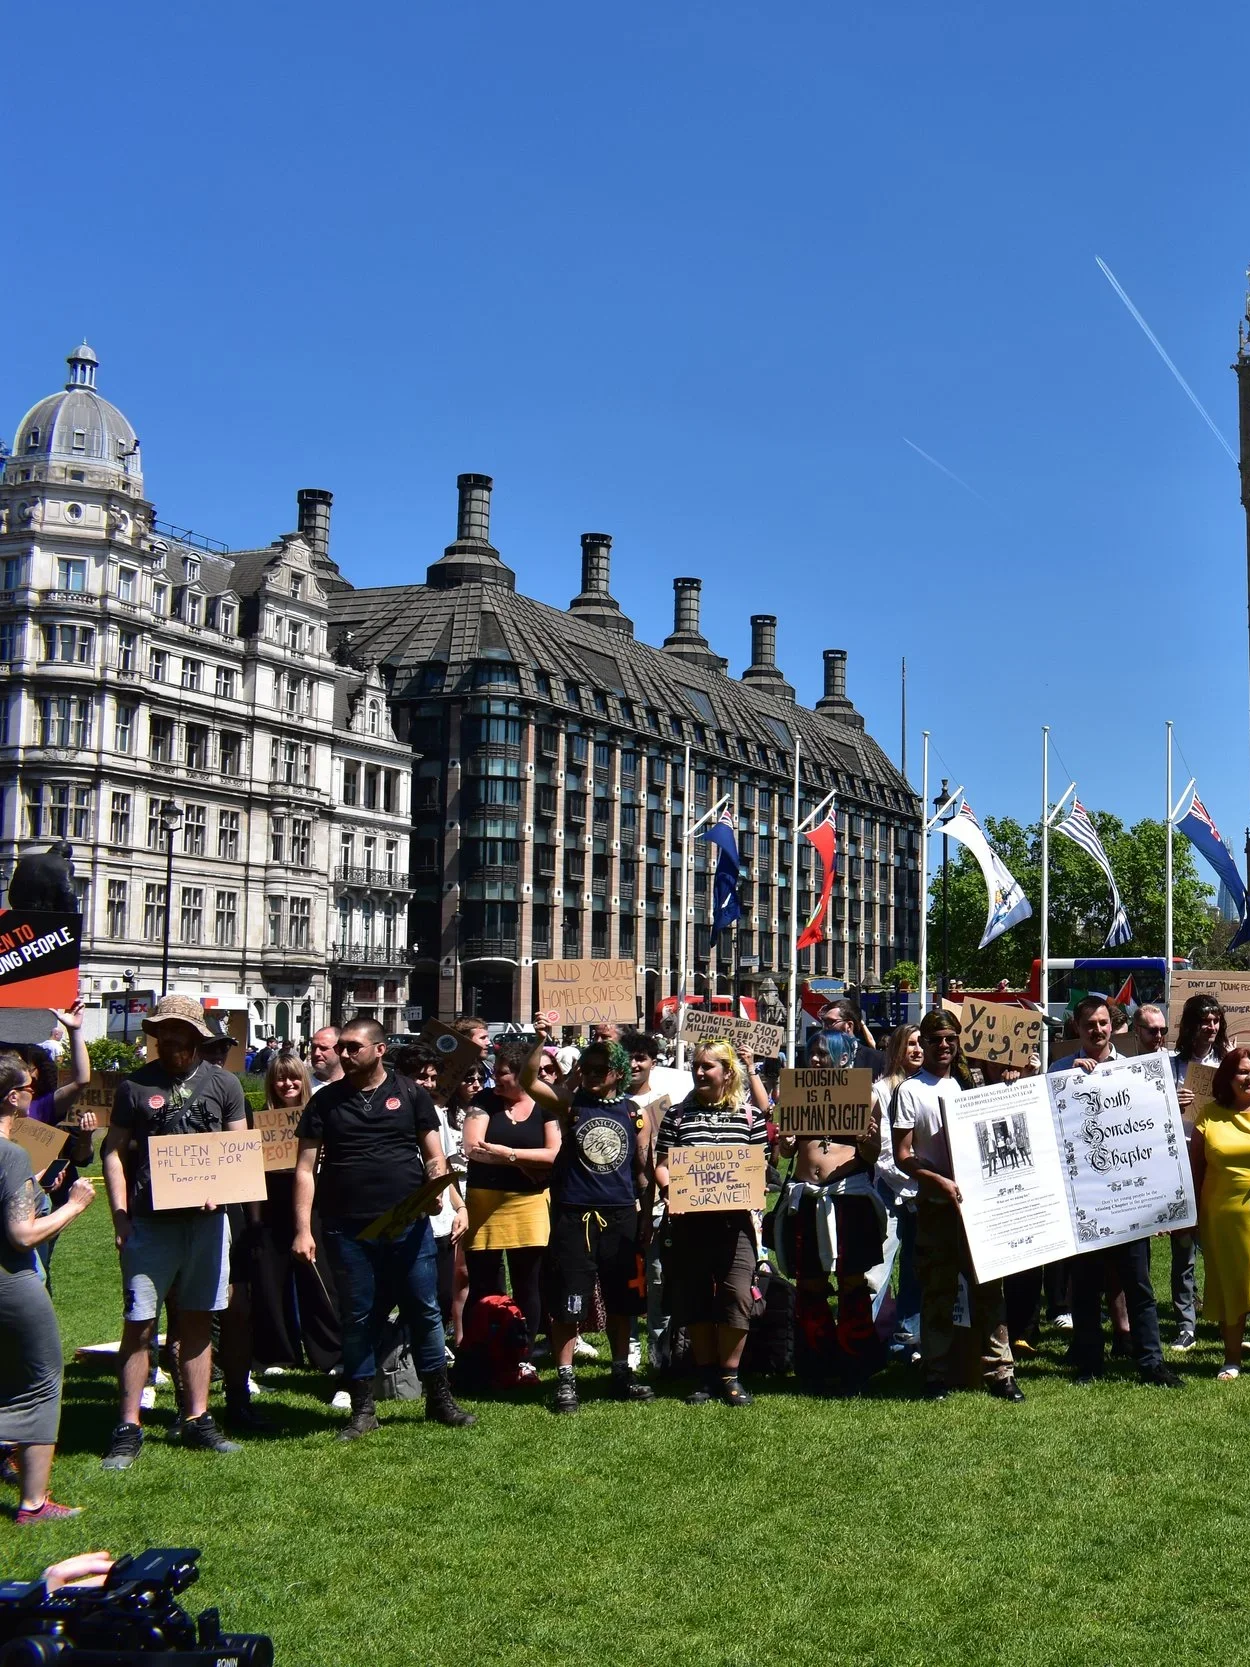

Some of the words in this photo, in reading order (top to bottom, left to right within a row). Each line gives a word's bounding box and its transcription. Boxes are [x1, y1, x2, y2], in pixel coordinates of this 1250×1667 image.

[12, 924, 35, 944] TO
[20, 926, 75, 962] PEOPLE
[543, 963, 581, 980] END
[590, 961, 634, 980] YOUTH
[1187, 980, 1205, 989] DON'T
[1206, 981, 1217, 989] LET
[1219, 981, 1240, 992] YOUNG
[1207, 990, 1219, 998] THE
[109, 998, 148, 1014] FeEx
[541, 985, 633, 1009] HOMELESSNESS
[565, 1004, 618, 1023] NOW!
[1222, 1004, 1250, 1014] CHAPTER
[686, 1011, 733, 1027] COUNCILS
[735, 1020, 751, 1029] NEED
[685, 1022, 720, 1035] MILLION
[724, 1028, 735, 1038] TO
[736, 1030, 754, 1041] END
[756, 1034, 780, 1048] YOUTH
[794, 1069, 849, 1088] HOUSING
[806, 1089, 818, 1103] IS
[823, 1089, 832, 1102] A
[1072, 1087, 1132, 1116] Youth
[780, 1104, 826, 1132] HUMAN
[828, 1103, 869, 1131] RIGHT
[1073, 1118, 1155, 1145] Homeless
[156, 1144, 209, 1157] HELPIN
[219, 1140, 262, 1154] YOUNG
[672, 1150, 691, 1165] WE
[694, 1149, 733, 1164] SHOULD
[737, 1148, 752, 1160] BE
[158, 1157, 174, 1168] PPL
[180, 1157, 212, 1167] LIVE
[218, 1154, 242, 1166] FOR
[688, 1161, 726, 1174] ALLOWED
[728, 1161, 740, 1169] TO
[1085, 1143, 1153, 1175] Chapter
[686, 1170, 738, 1187] THRIVE
[726, 1182, 751, 1191] BARELY
[689, 1189, 752, 1207] SURVIVE!!!
[216, 1657, 239, 1667] RONIN
